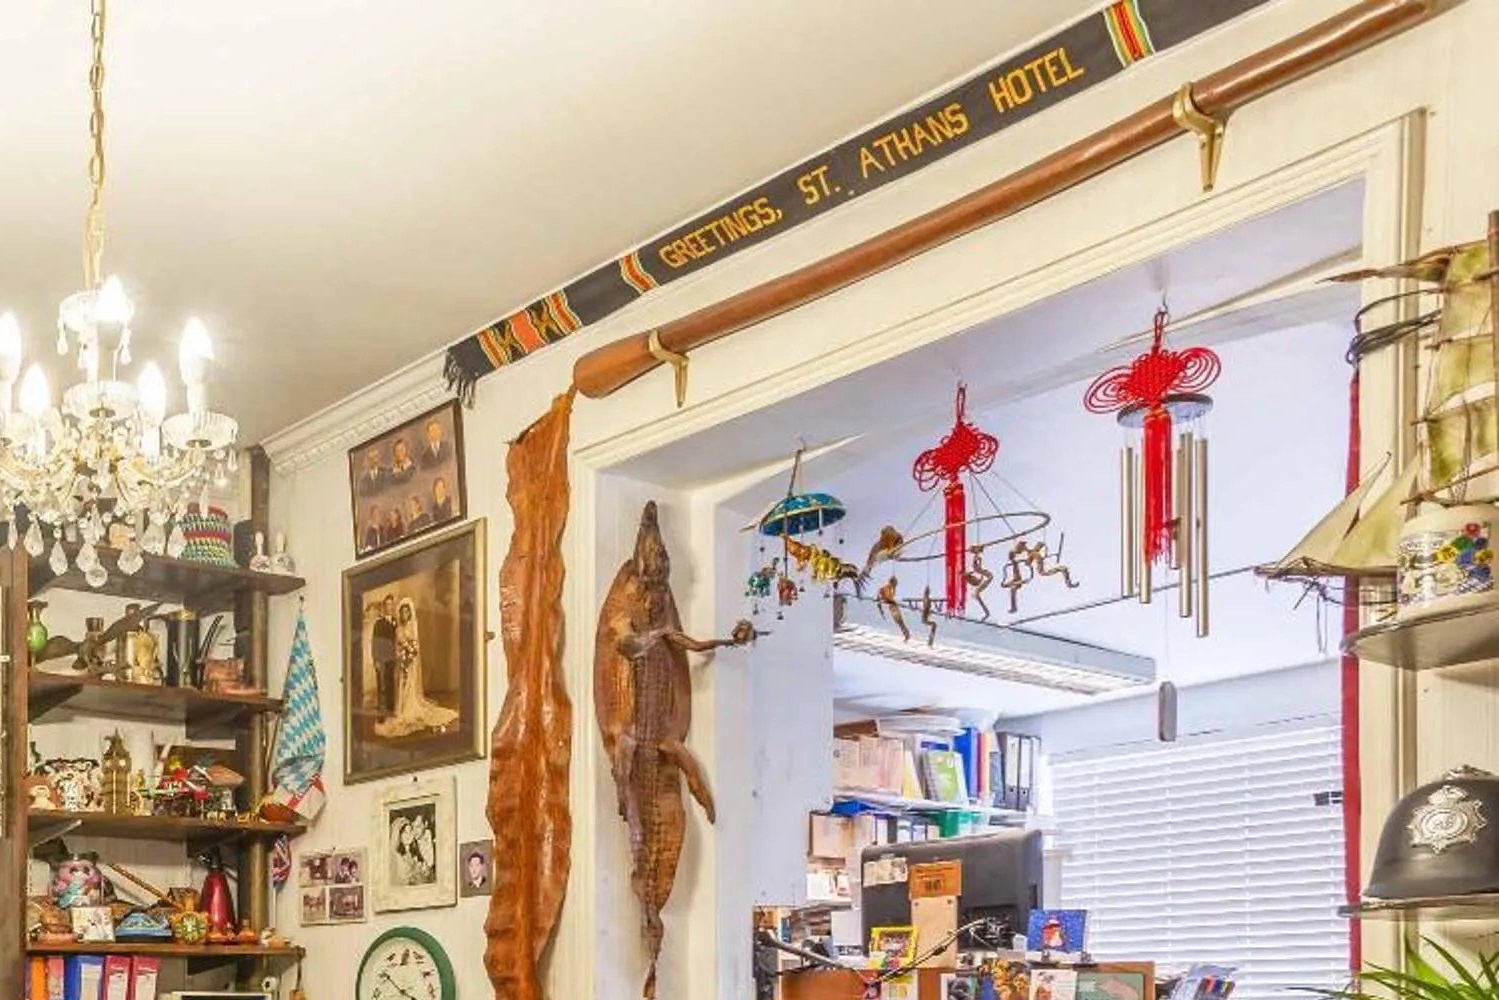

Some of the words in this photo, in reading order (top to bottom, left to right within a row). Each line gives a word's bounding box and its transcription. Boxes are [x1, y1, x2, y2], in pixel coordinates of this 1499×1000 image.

[658, 197, 783, 269] GREETINGS,
[798, 165, 842, 208] ST.
[859, 104, 968, 180] ATHANS
[989, 47, 1086, 114] HOTEL
